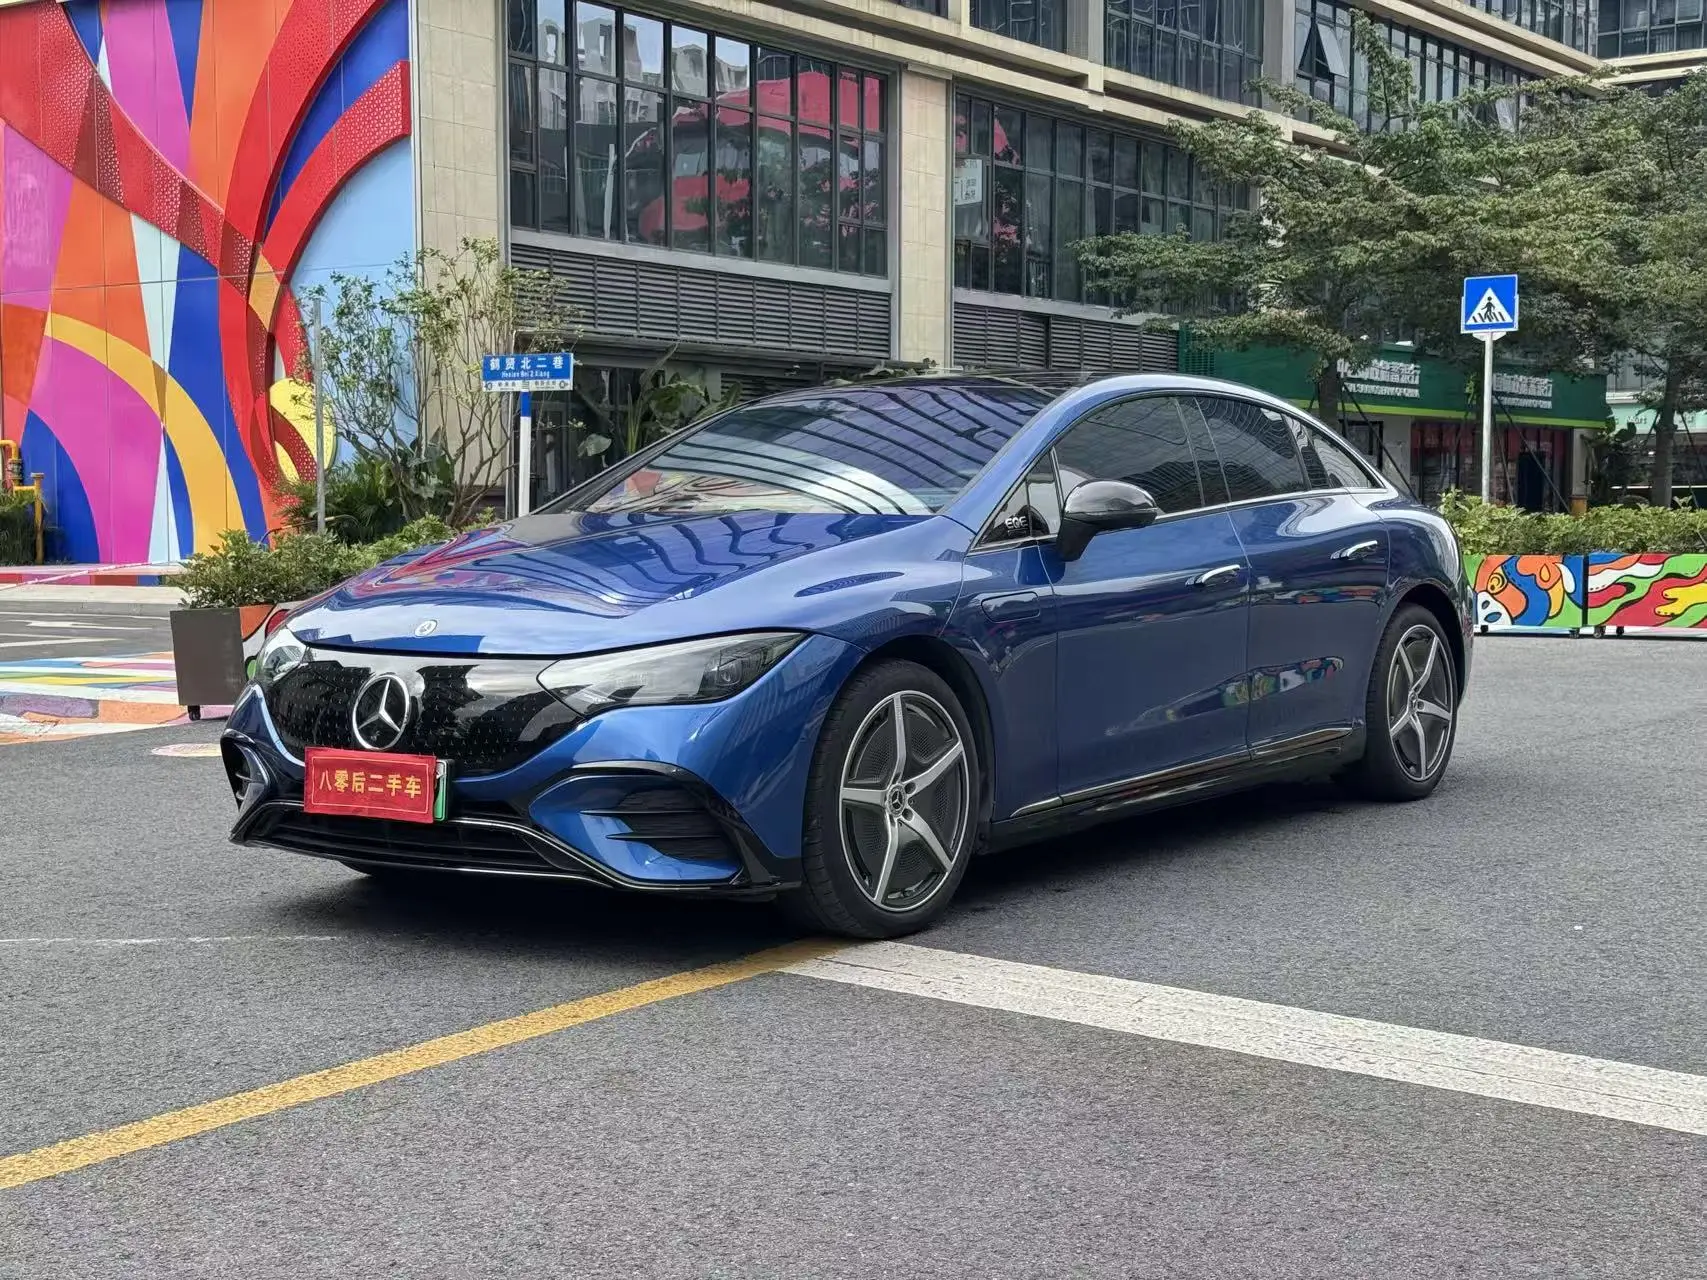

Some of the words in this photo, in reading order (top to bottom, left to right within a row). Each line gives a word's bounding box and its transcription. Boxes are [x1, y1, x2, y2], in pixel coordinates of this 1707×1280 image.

[490, 356, 564, 371] 鹤贤北二巷
[319, 769, 422, 799] 八零后二手车
